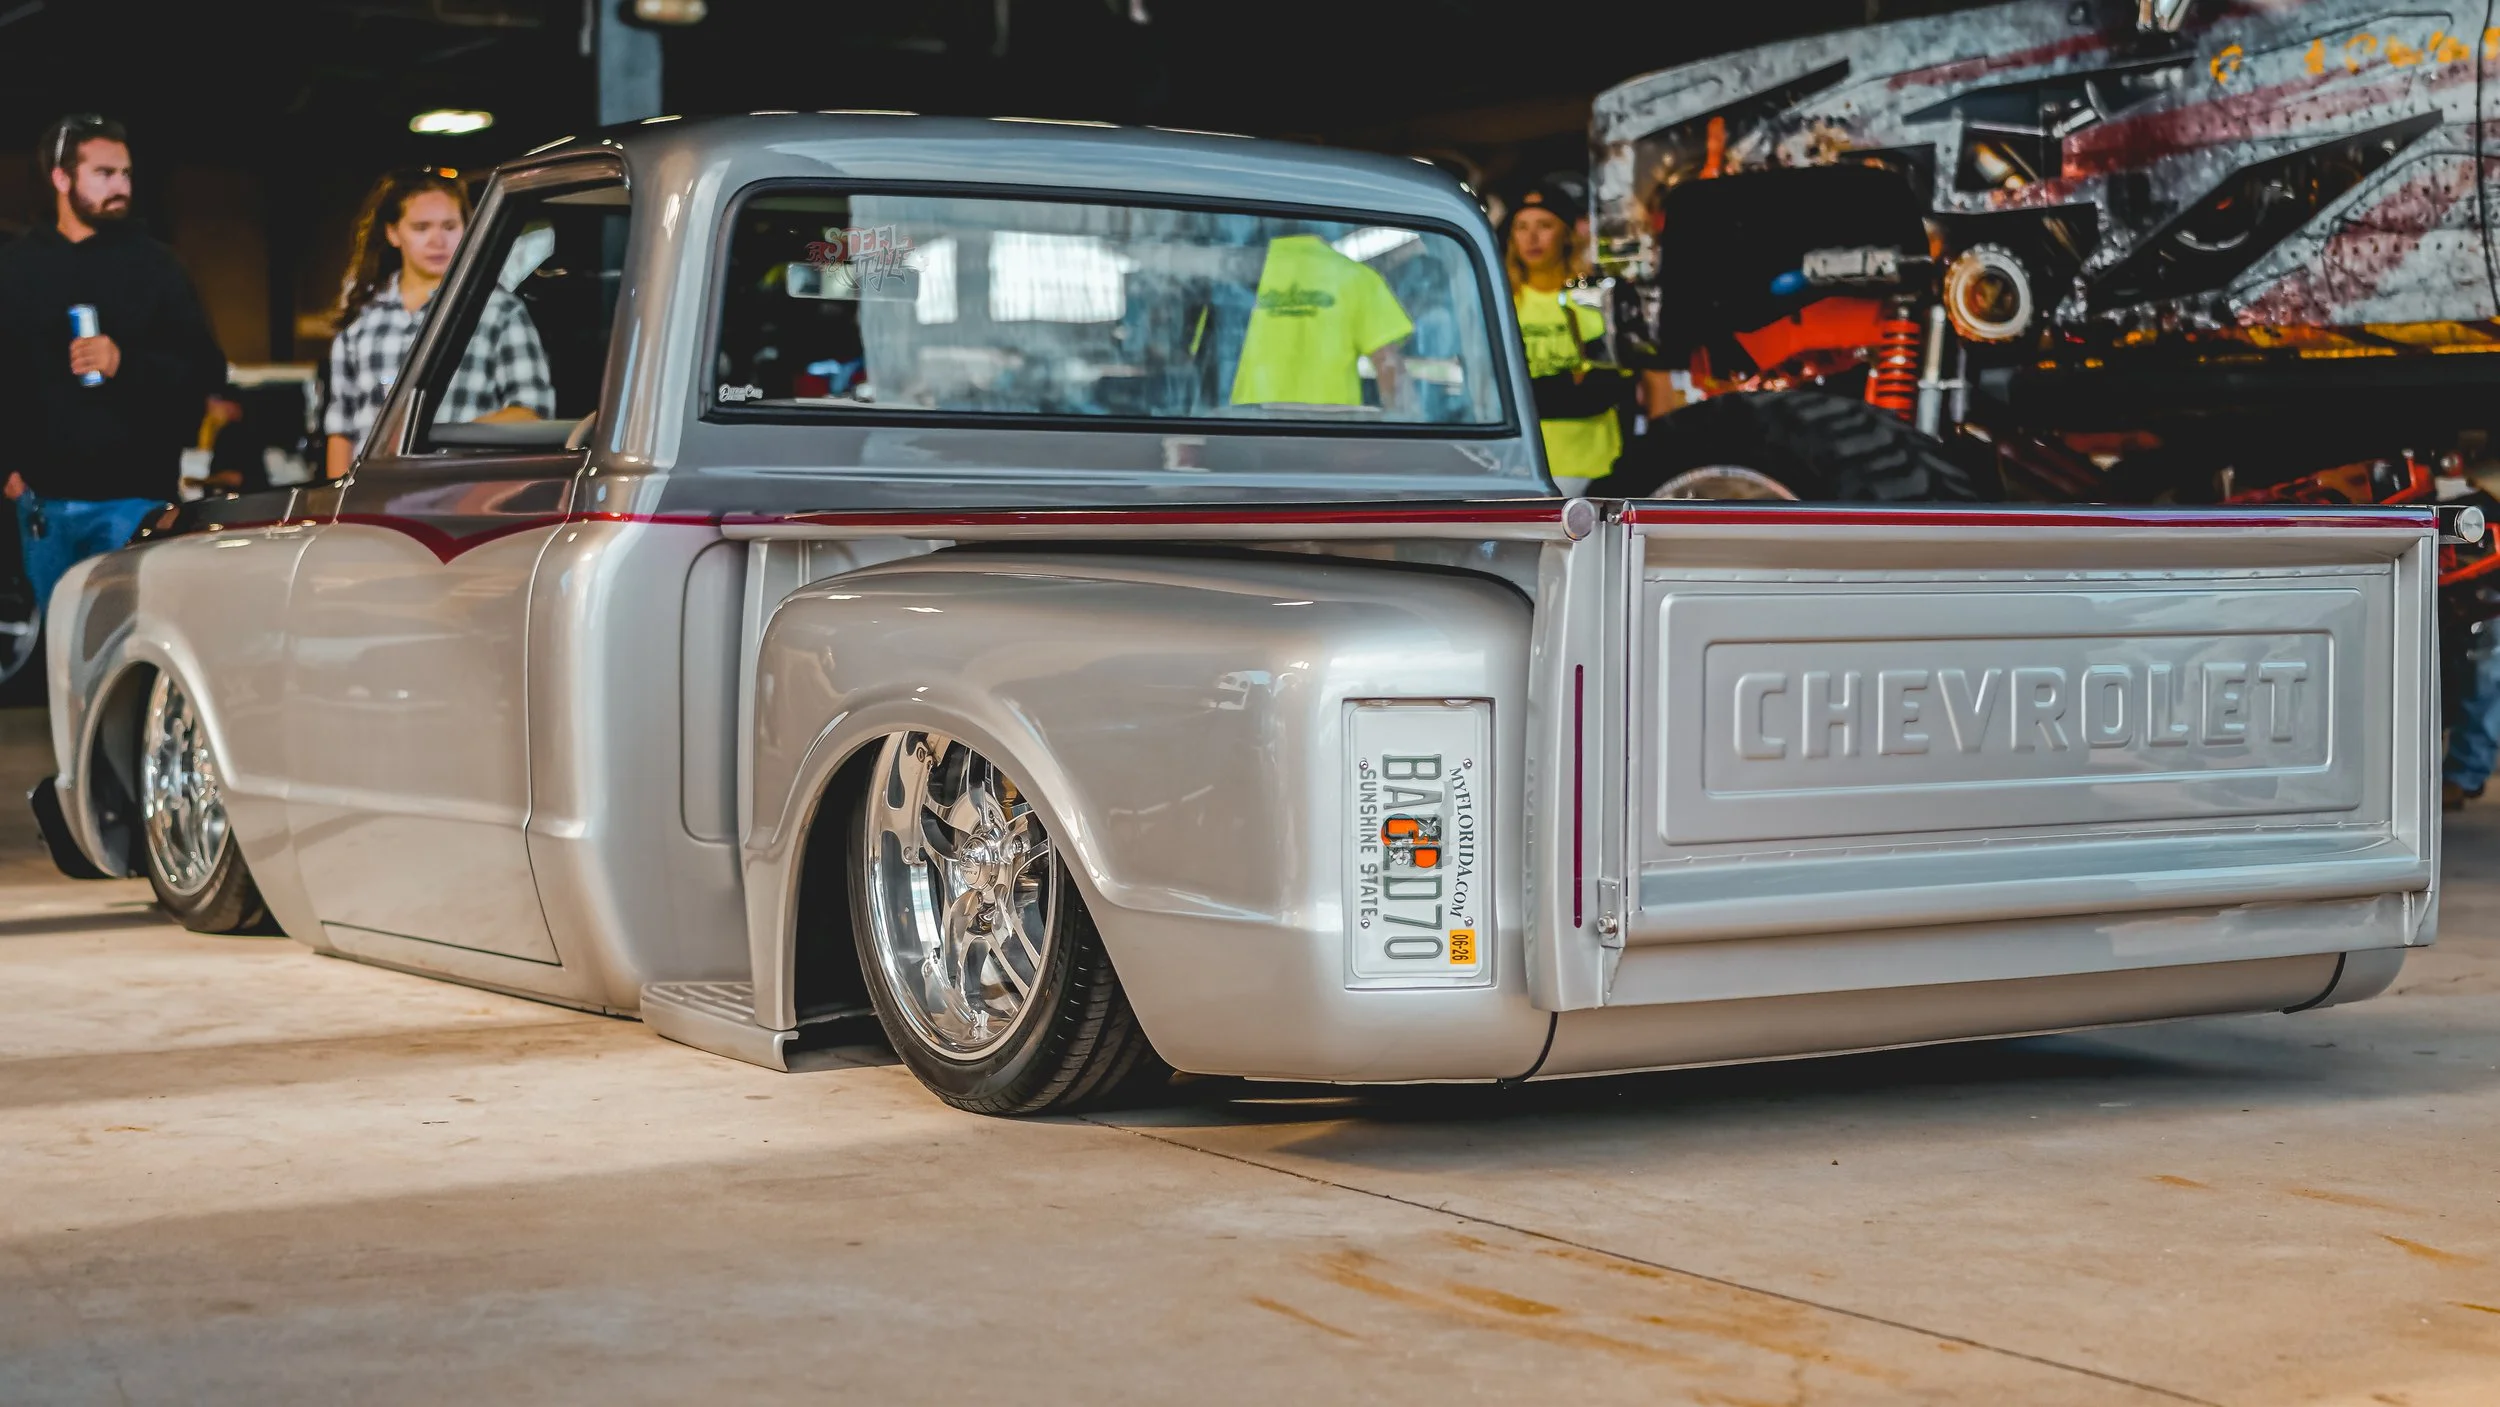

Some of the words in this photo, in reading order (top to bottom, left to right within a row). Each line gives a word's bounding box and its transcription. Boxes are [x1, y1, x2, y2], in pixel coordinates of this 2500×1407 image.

[823, 224, 909, 260] STEEL
[1733, 661, 2308, 760] CHEVROLET
[1360, 768, 1378, 854] SUNSHINE
[1449, 766, 1475, 918] MYFLORIDA.COM
[1360, 862, 1378, 917] STATE
[1452, 933, 1469, 961] 06-26
